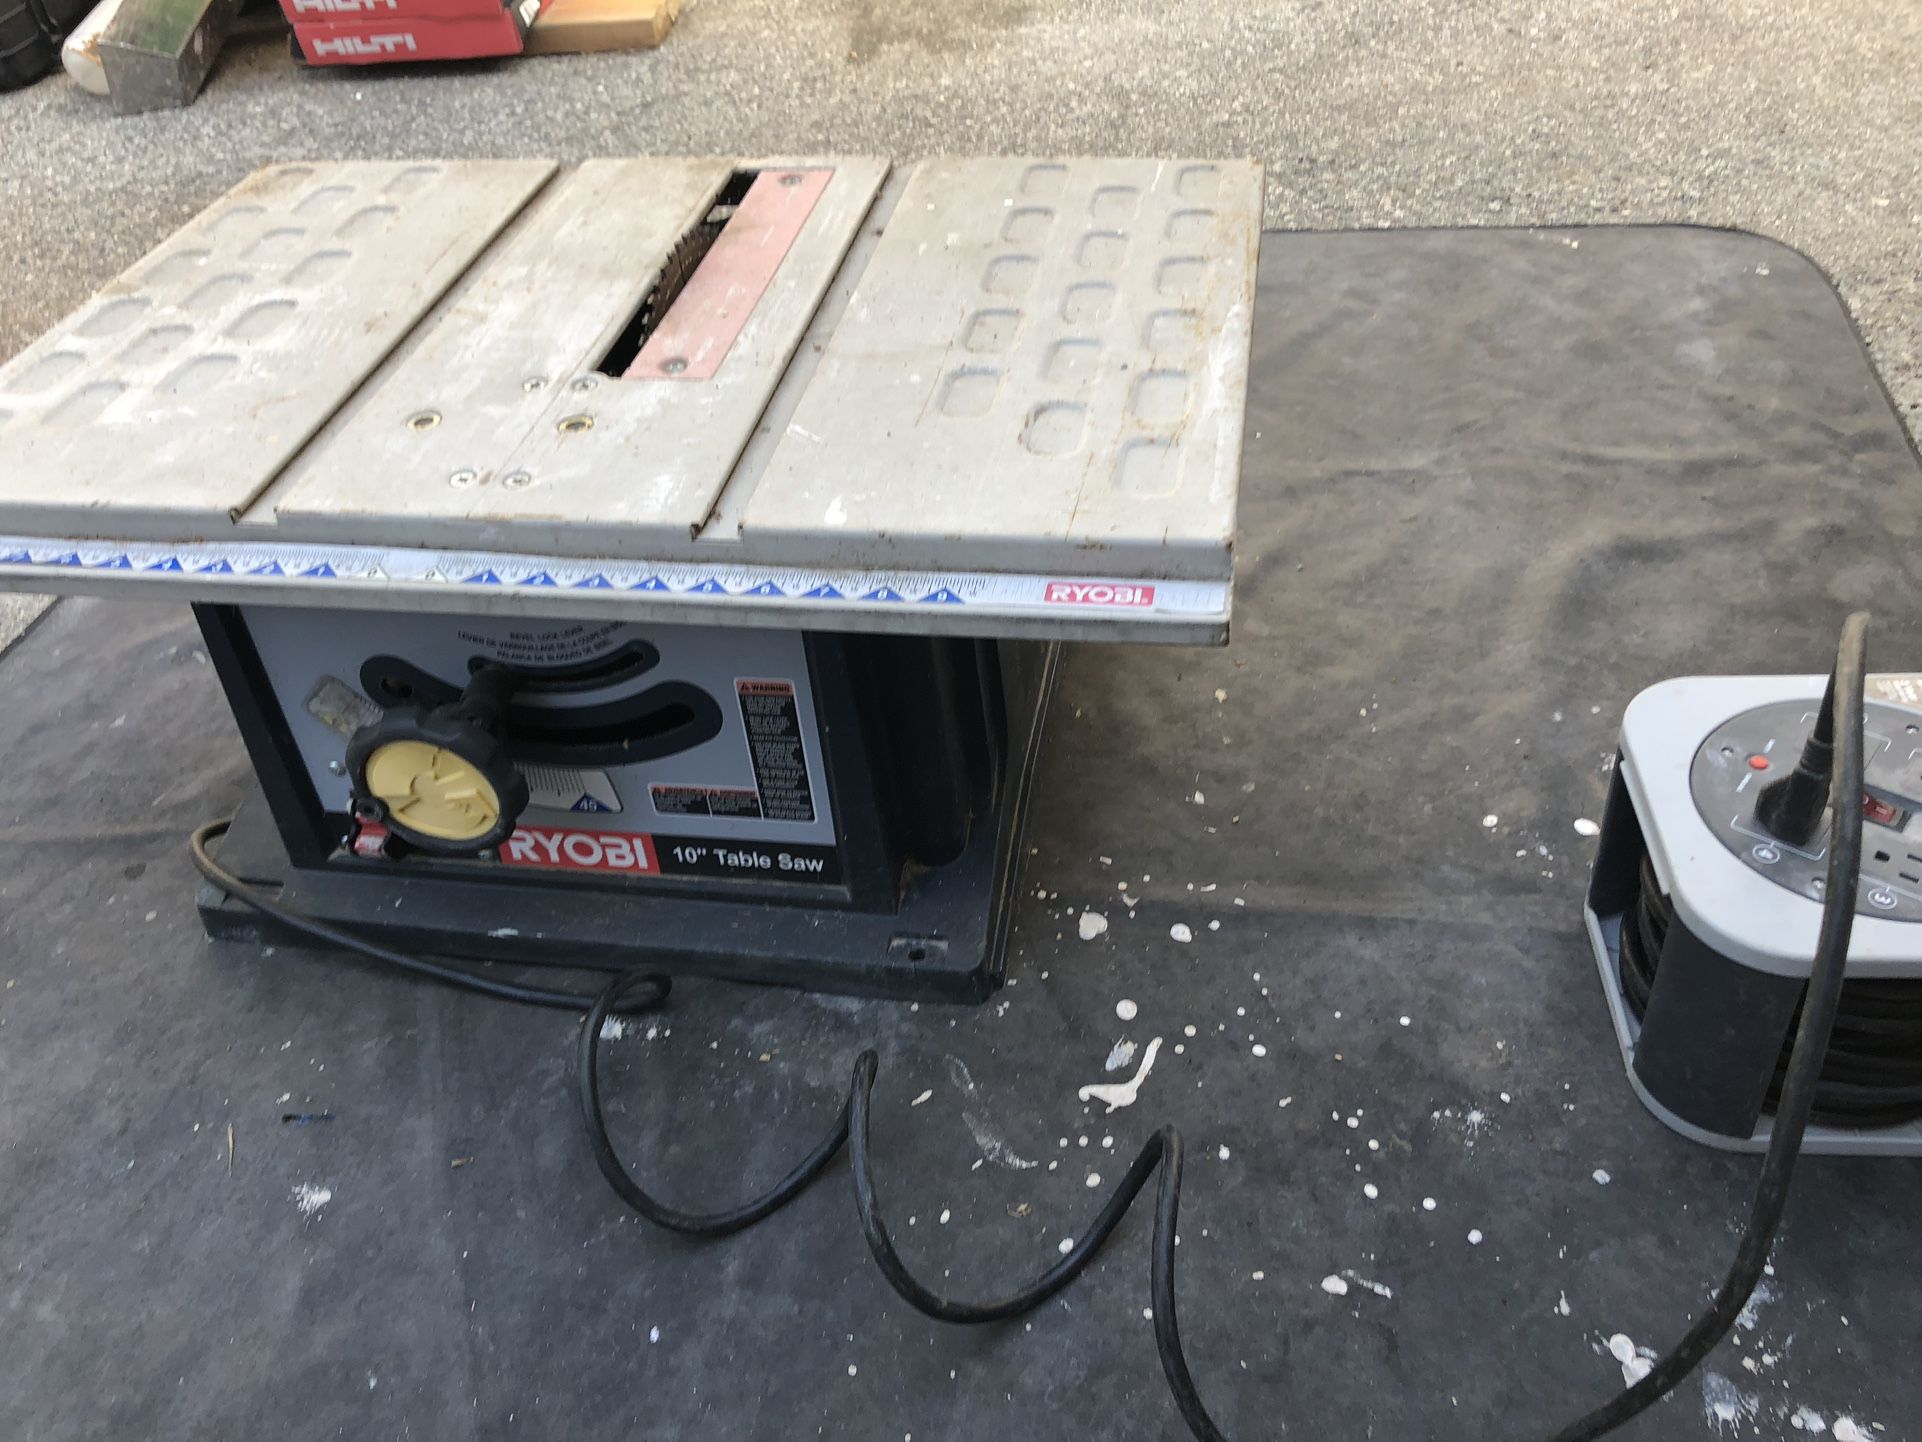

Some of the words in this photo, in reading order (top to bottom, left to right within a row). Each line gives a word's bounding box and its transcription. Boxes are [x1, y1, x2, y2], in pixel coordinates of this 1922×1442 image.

[313, 33, 417, 56] HILTI
[509, 829, 649, 869] RYOBI
[714, 849, 771, 869] Table
[778, 854, 824, 873] Saw
